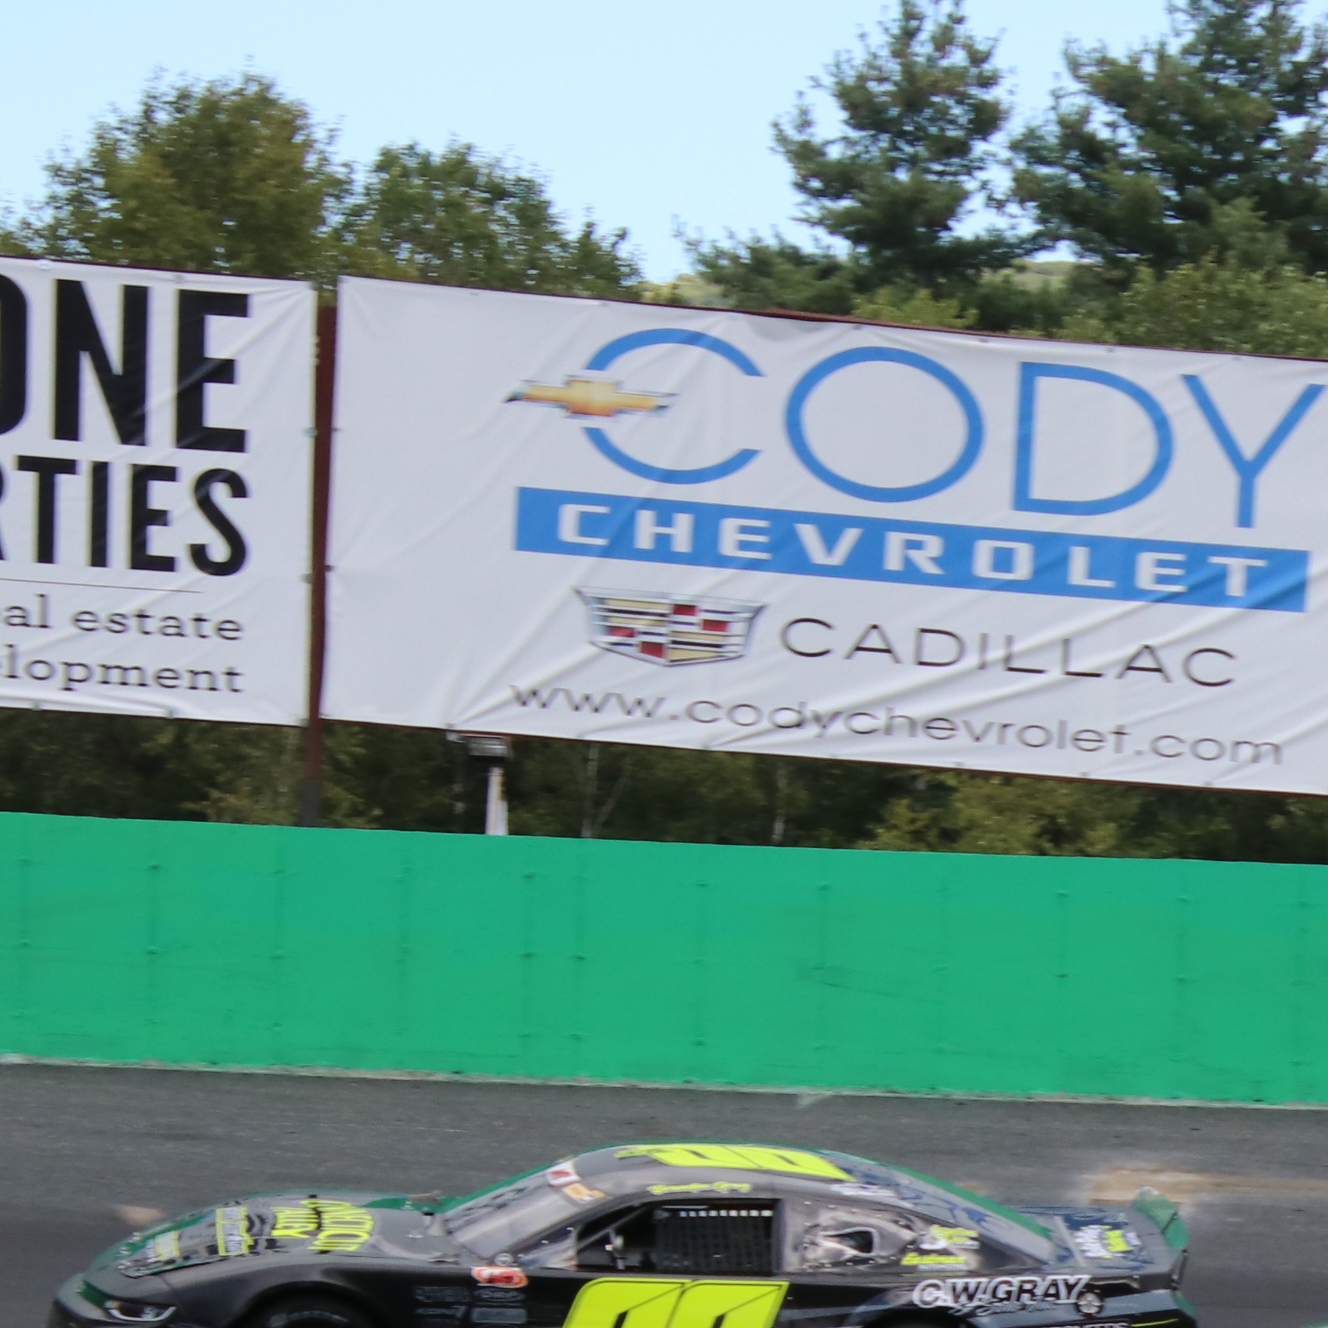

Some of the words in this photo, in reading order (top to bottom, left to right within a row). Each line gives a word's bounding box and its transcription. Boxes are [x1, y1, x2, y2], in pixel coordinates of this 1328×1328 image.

[583, 328, 1327, 529] CODY
[557, 504, 1268, 597] CHEVROLET
[73, 608, 244, 641] estate
[781, 617, 1237, 687] CADILLAC
[0, 644, 244, 693] lopment
[511, 685, 1283, 766] www.codychevrolet.com
